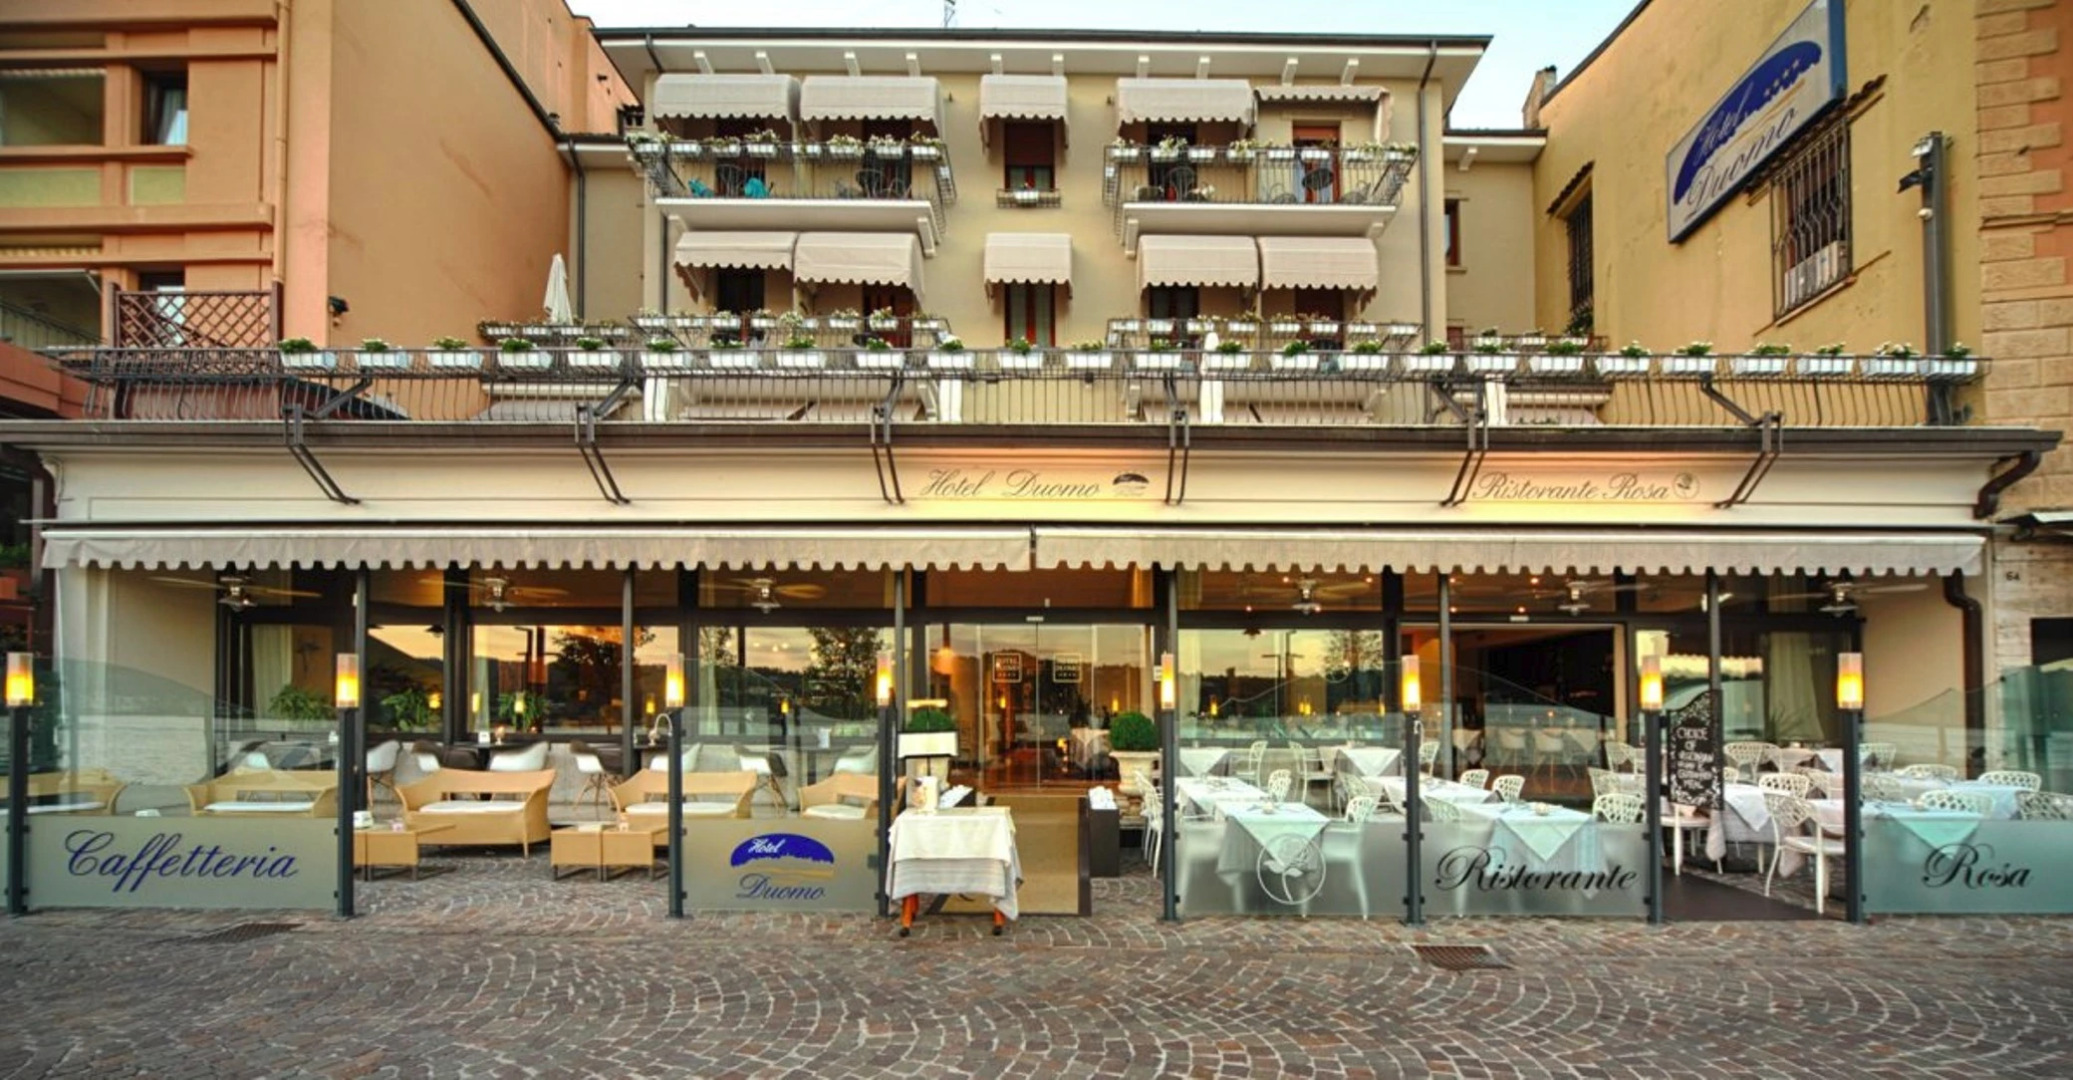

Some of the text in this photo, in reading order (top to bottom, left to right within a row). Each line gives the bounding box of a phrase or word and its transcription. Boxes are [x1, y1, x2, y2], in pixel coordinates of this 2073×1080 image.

[1693, 82, 1754, 166] Hotel
[1684, 108, 1798, 222] Duomo
[920, 469, 1100, 498] Hotel Duomo
[1473, 471, 1670, 500] Ristorante Rosa
[65, 829, 298, 893] Caffetteria
[747, 838, 787, 854] Hotel
[1435, 845, 1638, 892] Ristorante
[1921, 843, 2034, 890] Rosa
[735, 873, 826, 900] Duomo
